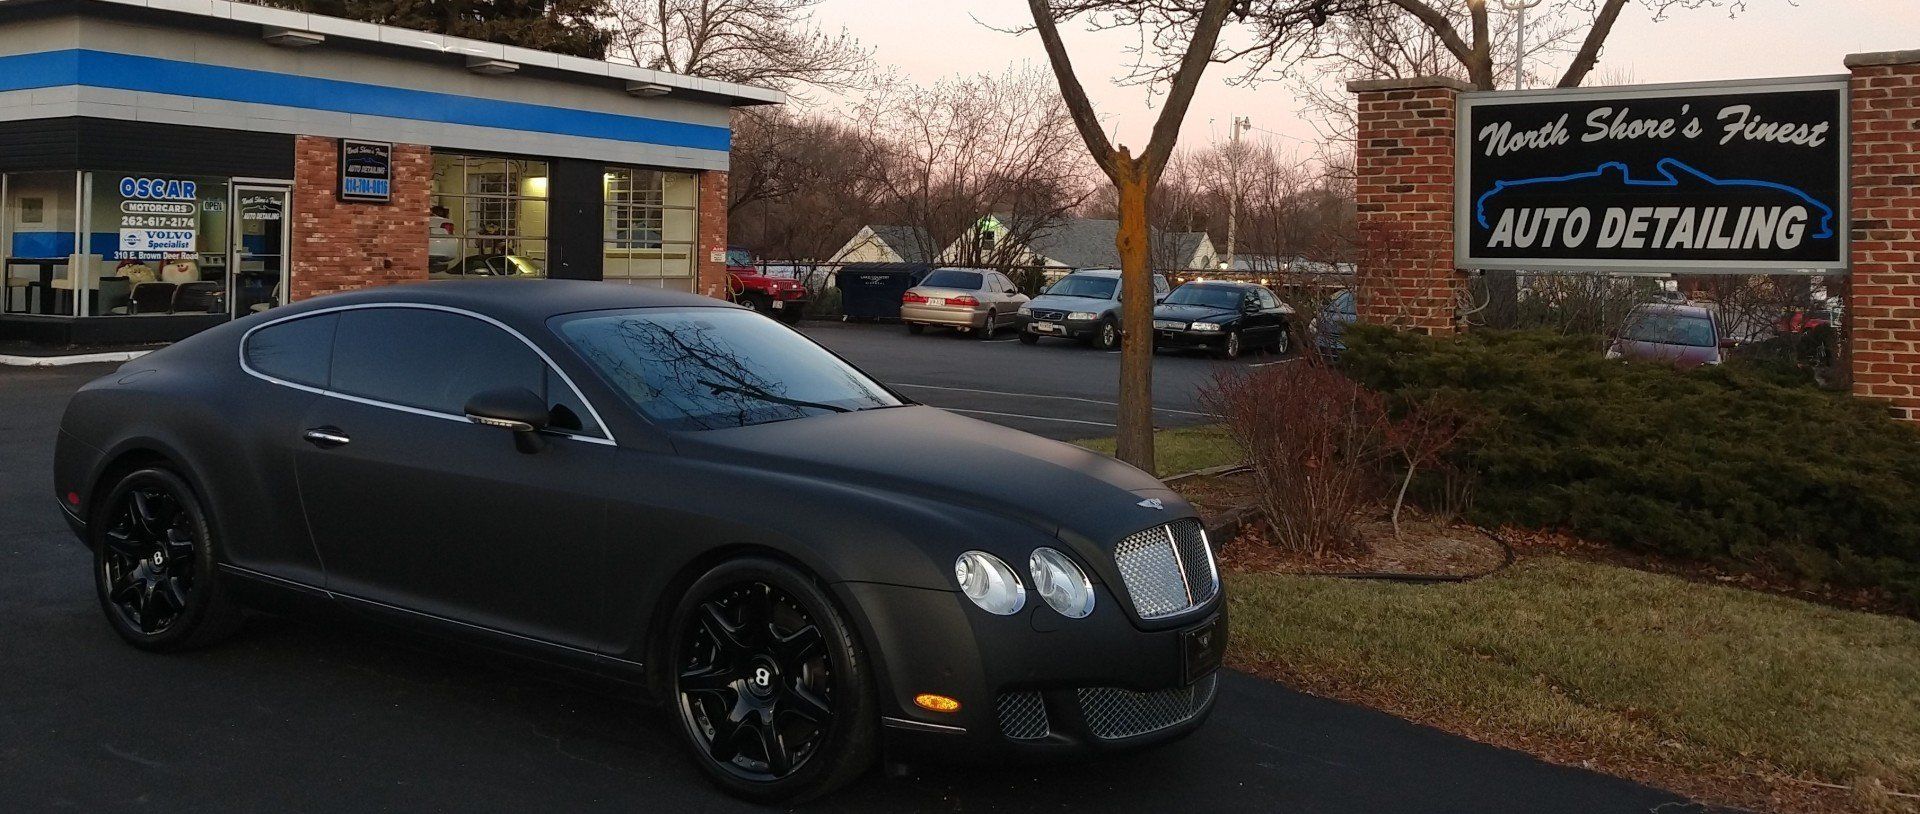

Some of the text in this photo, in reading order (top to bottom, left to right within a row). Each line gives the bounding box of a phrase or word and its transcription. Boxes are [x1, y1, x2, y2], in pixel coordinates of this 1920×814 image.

[1478, 103, 1829, 156] North Shore's Finest
[348, 164, 386, 174] AUTO DETAILING
[120, 177, 196, 200] OSCAR
[129, 203, 188, 213] MOTORCARS
[243, 212, 256, 220] AUTO
[121, 216, 195, 228] 262-617-2174
[1486, 205, 1808, 250] AUTO DETAILING
[145, 231, 193, 240] VOLVO
[148, 240, 189, 250] Specialist
[114, 251, 199, 260] 310 E. Brown Deer Road
